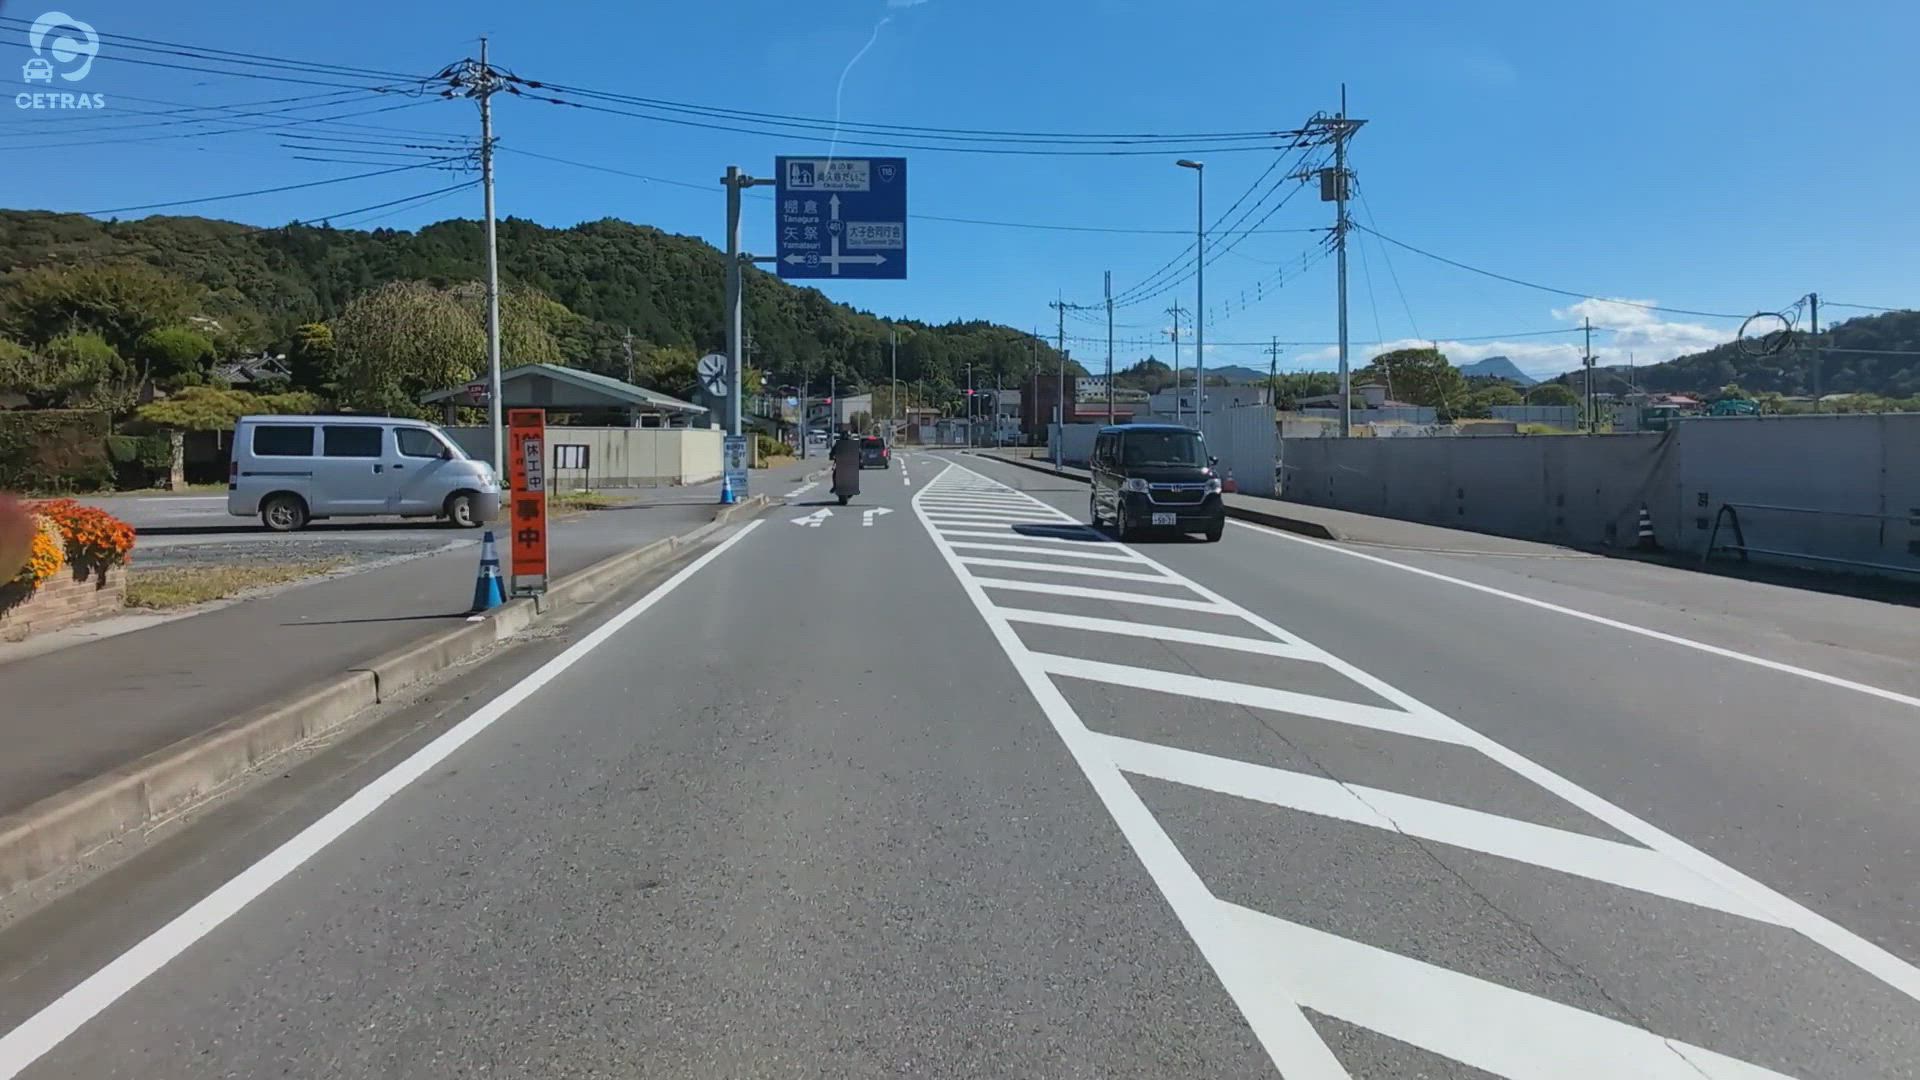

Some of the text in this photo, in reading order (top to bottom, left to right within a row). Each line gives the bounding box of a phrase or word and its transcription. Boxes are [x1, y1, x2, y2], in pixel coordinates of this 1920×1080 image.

[784, 200, 818, 214] 棚倉
[807, 254, 817, 264] 28
[527, 443, 542, 490] 休工中
